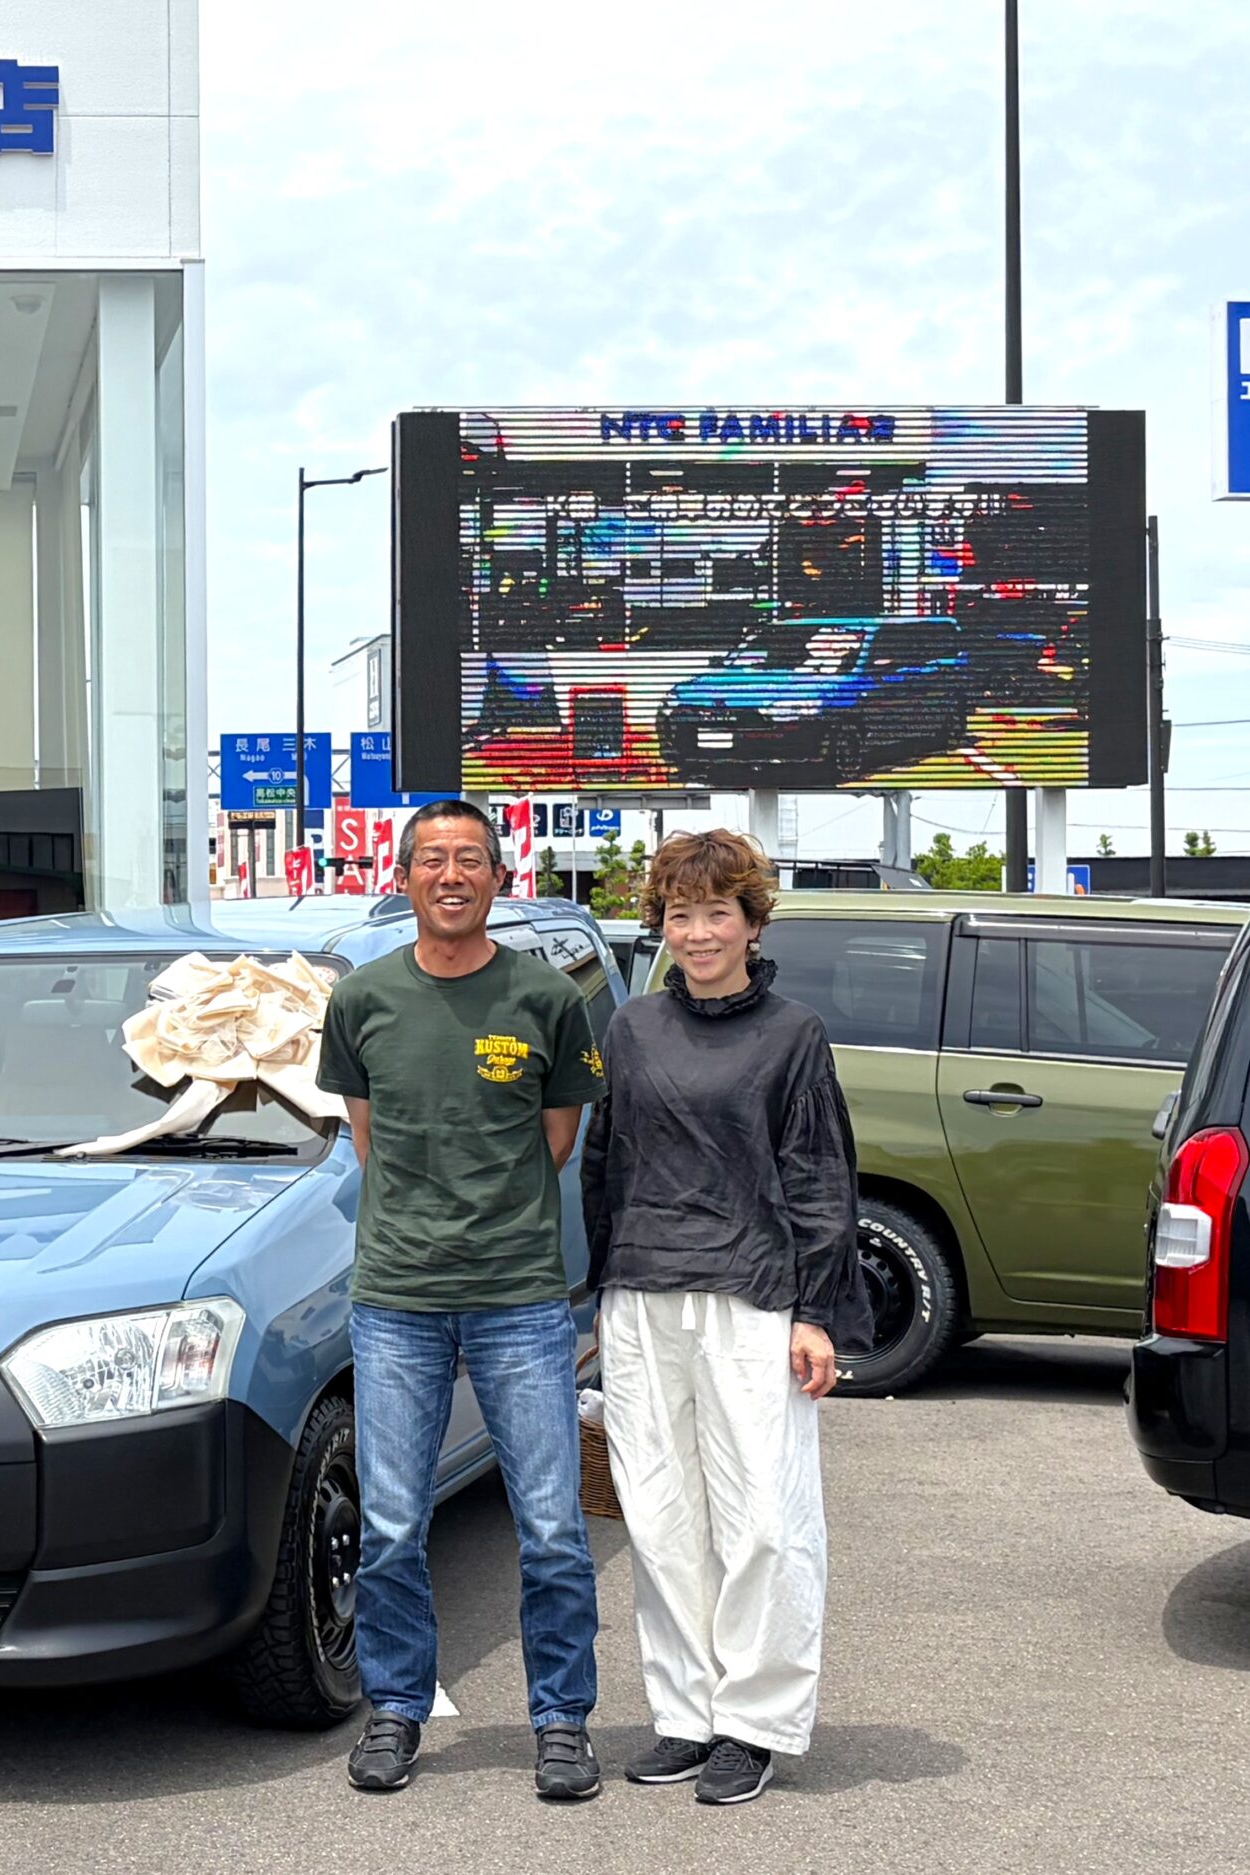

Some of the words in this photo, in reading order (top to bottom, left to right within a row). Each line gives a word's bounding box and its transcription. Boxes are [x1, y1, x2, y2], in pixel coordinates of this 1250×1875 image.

[271, 770, 282, 781] 10
[857, 1218, 928, 1281] COUNTRY
[920, 1284, 932, 1323] R/T
